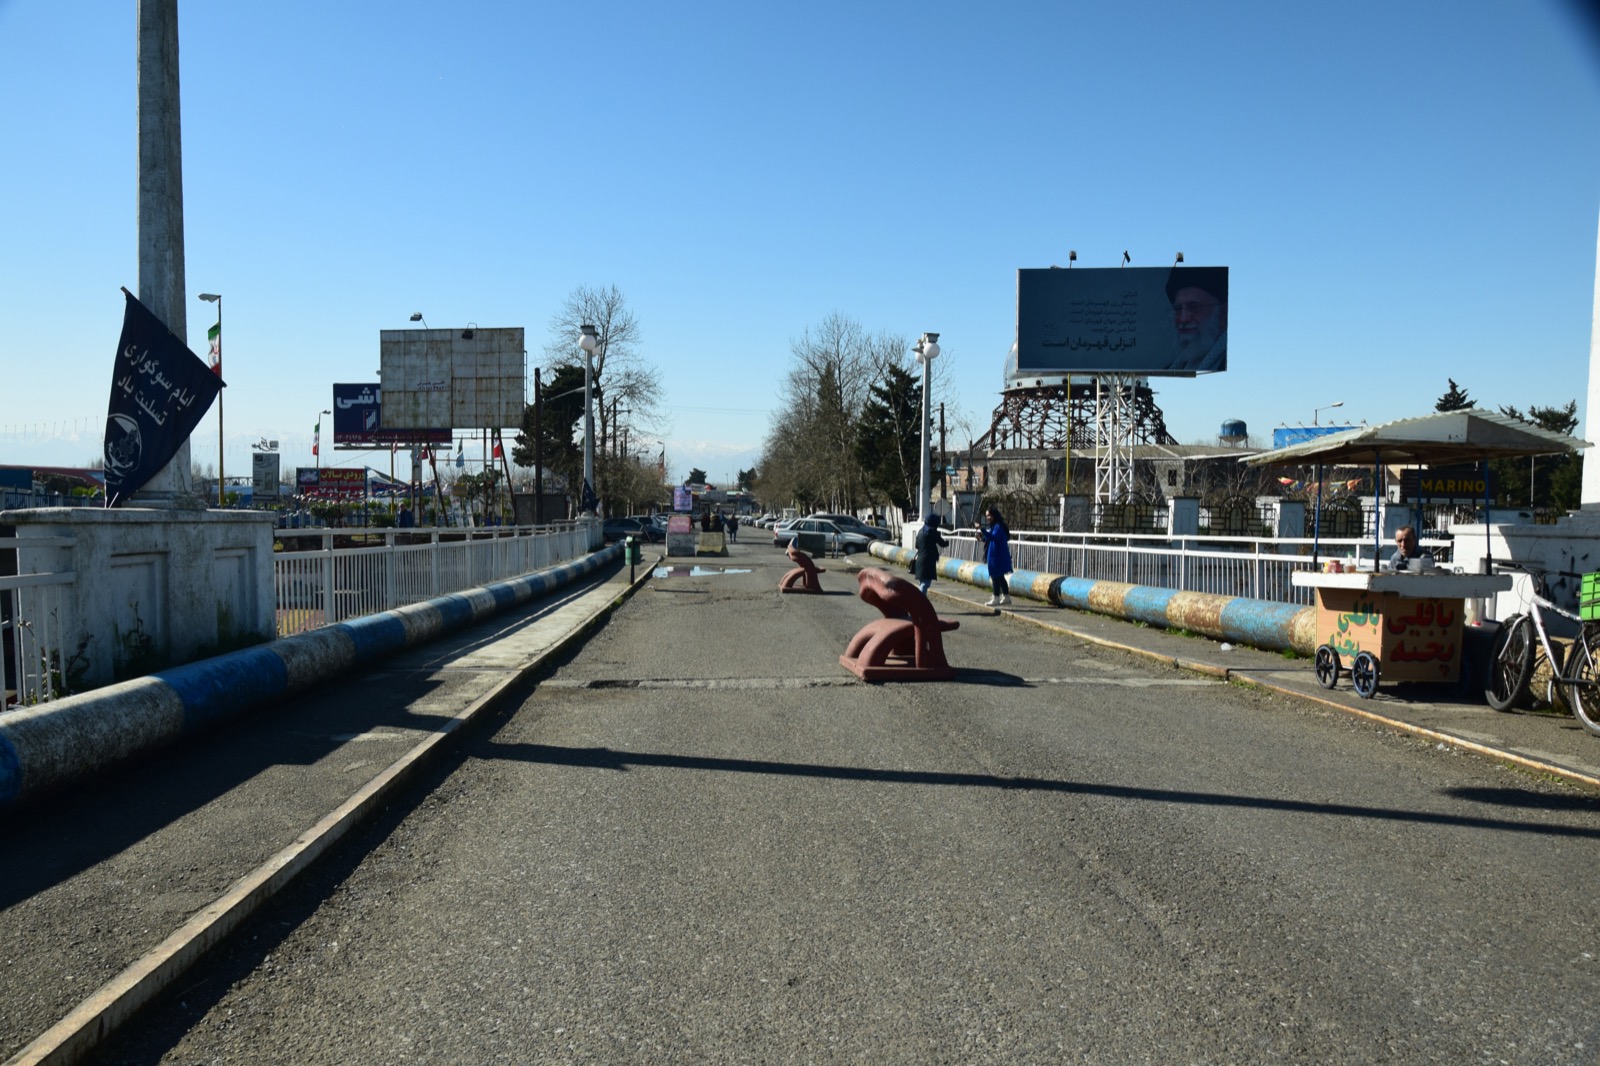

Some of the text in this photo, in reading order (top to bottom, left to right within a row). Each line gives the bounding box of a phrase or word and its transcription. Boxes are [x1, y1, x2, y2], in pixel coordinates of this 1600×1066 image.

[1042, 336, 1136, 351] انزلی قهرمان است
[124, 344, 195, 411] ایام سوگواری
[117, 374, 168, 426] تسلیت باد
[1420, 479, 1486, 493] MARINO
